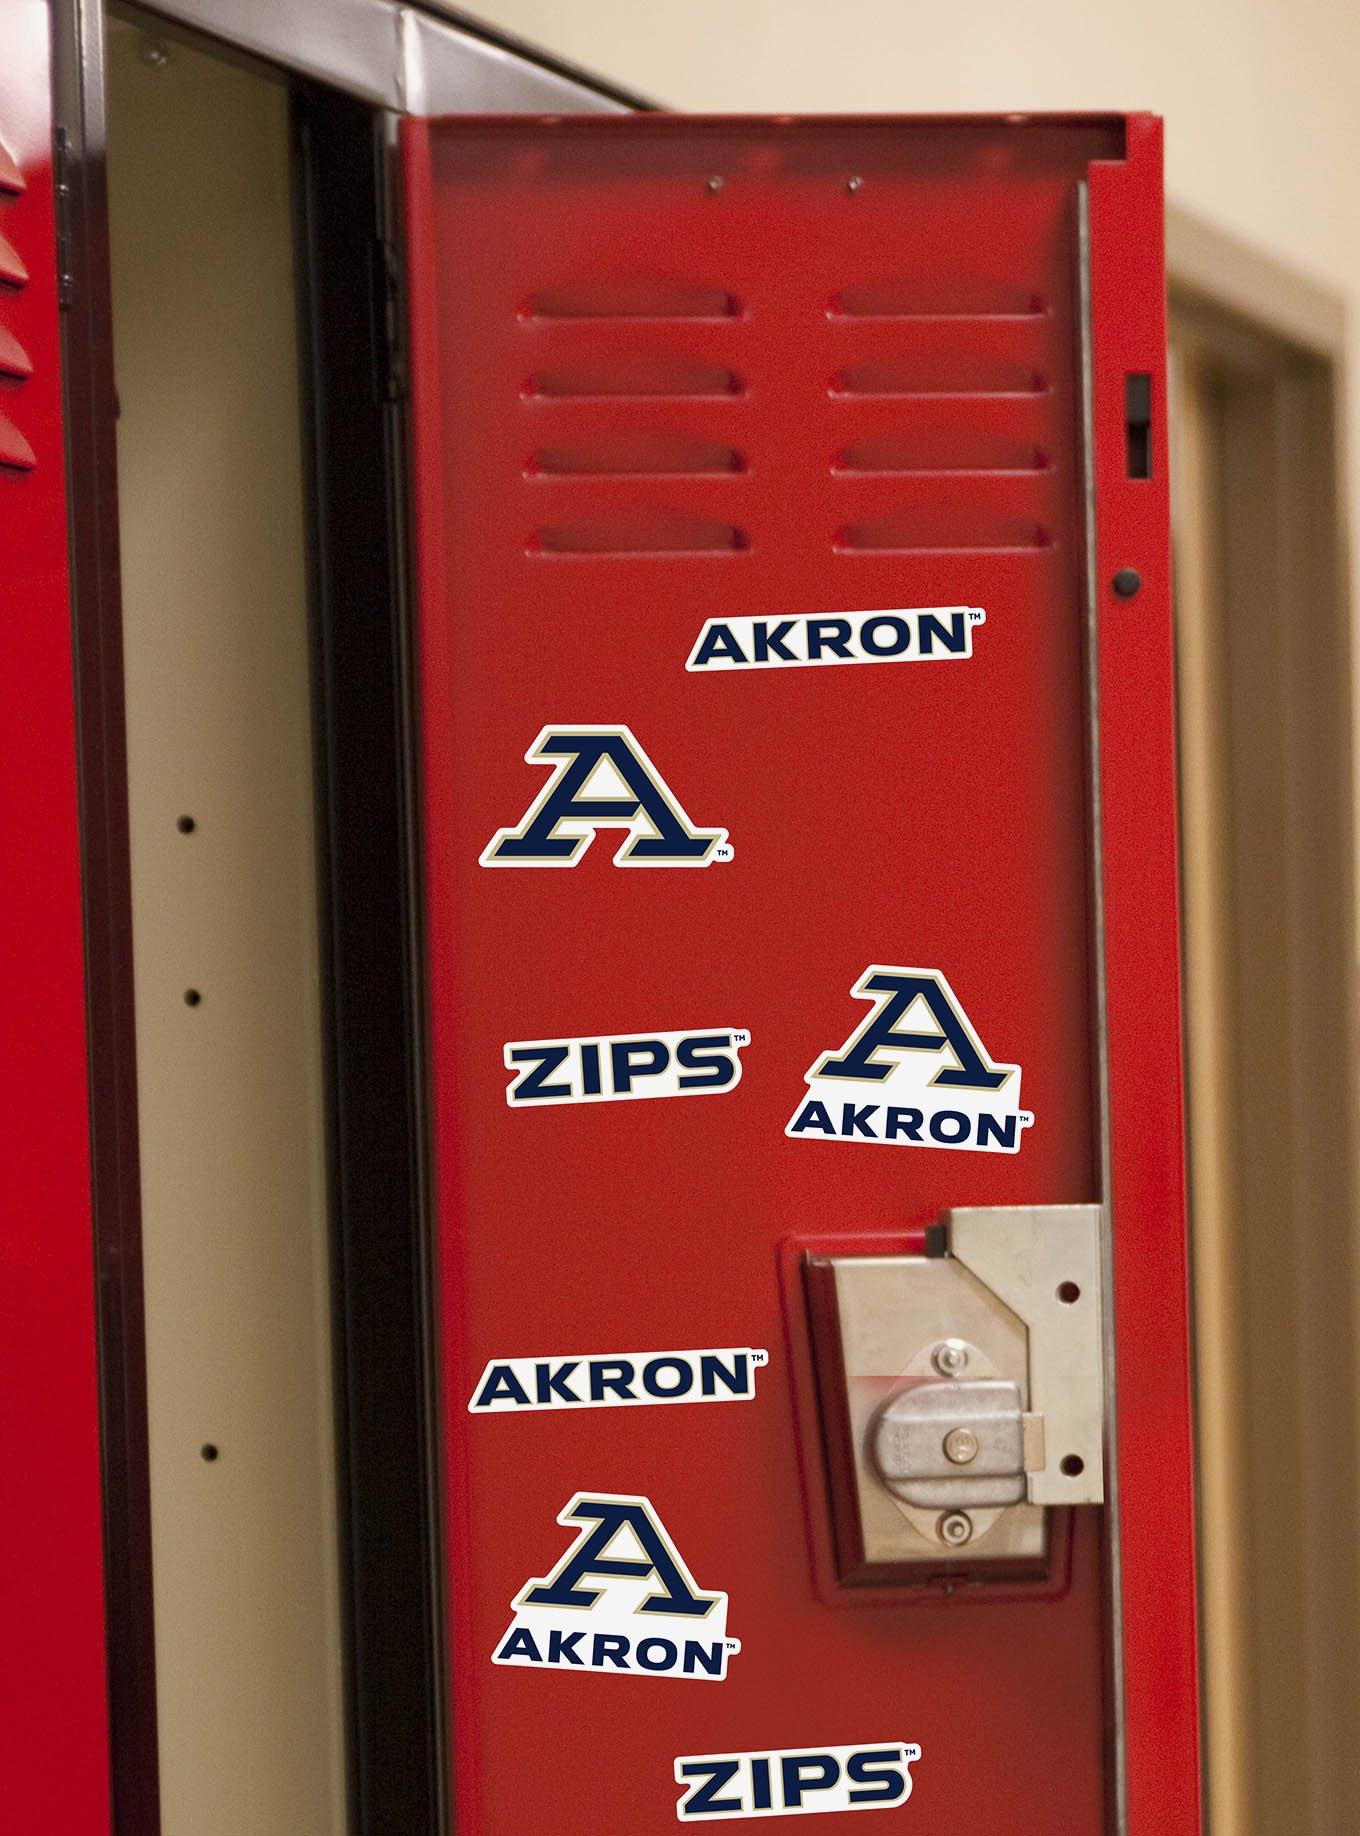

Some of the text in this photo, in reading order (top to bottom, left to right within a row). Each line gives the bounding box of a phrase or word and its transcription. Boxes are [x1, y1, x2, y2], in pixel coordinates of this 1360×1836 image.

[691, 612, 967, 666] AKRON
[486, 731, 722, 861] A
[811, 971, 1015, 1092] A
[510, 1034, 736, 1101] ZIPS
[791, 1100, 1017, 1149] AKRON
[474, 1354, 750, 1408] AKRON
[518, 1498, 722, 1619] A
[497, 1627, 723, 1676] AKRON
[680, 1748, 906, 1816] ZIPS
